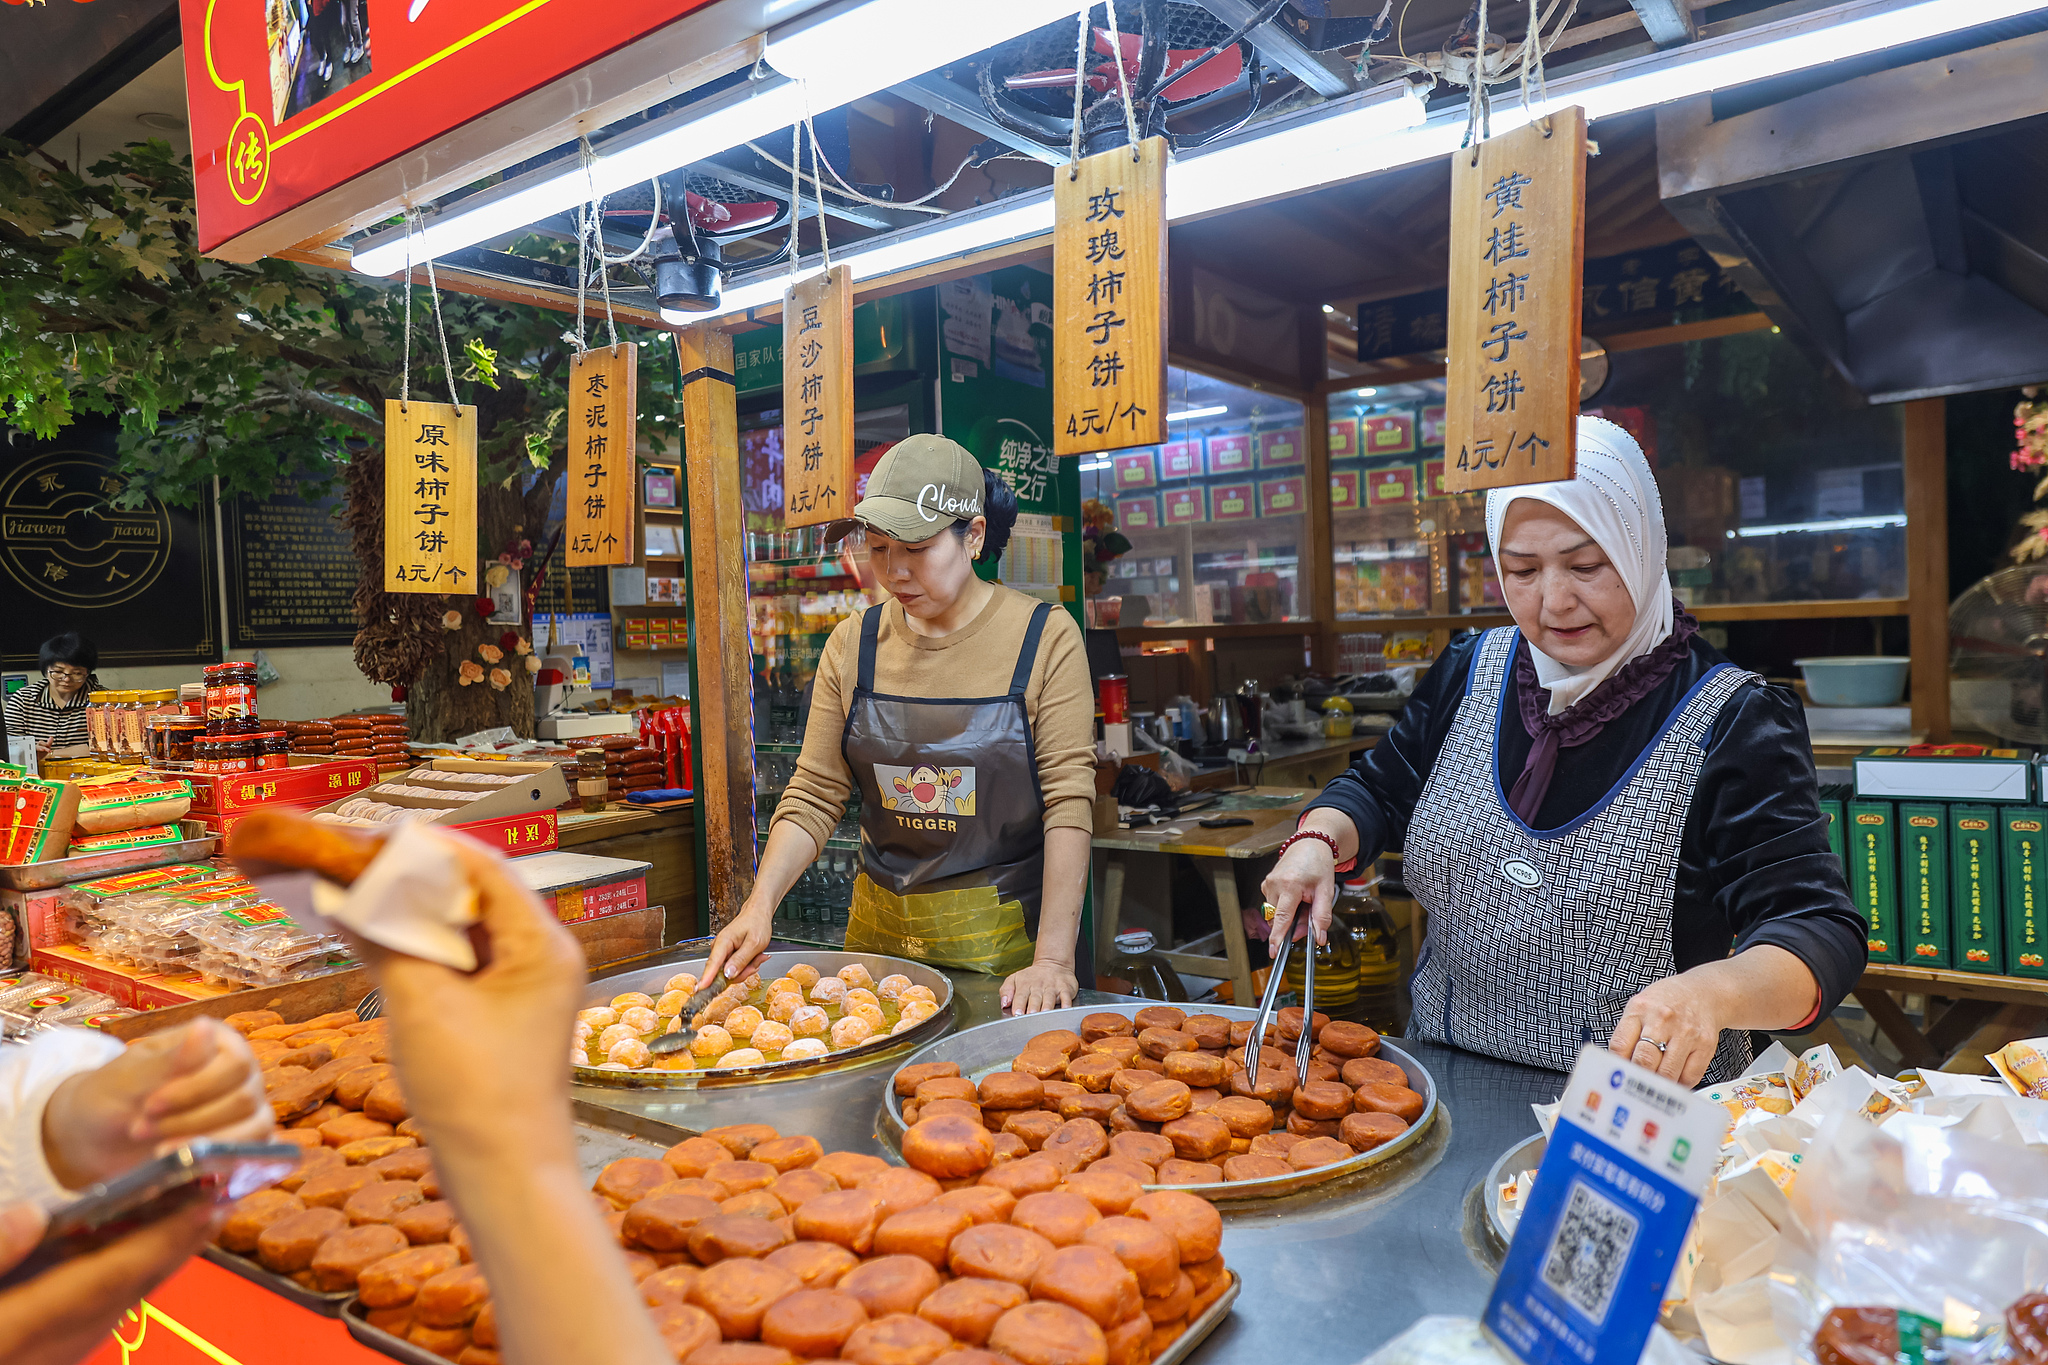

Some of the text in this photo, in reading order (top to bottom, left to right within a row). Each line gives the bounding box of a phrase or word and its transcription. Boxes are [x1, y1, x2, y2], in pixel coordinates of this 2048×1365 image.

[234, 132, 265, 187] 传
[1085, 186, 1126, 388] 玫瑰柿子饼
[1481, 171, 1532, 414] 黄桂柿子饼
[799, 304, 824, 472] 豆沙柿子饼
[1066, 401, 1147, 437] 4元/个
[584, 373, 609, 520] 枣泥柿子饼
[998, 438, 1060, 475] 纯净之道
[1456, 430, 1550, 473] 4元/个
[414, 423, 450, 553] 原味柿子饼
[790, 484, 837, 514] 4元/个
[572, 530, 618, 554] 4元/个
[395, 562, 467, 585] 4元/个
[328, 770, 362, 789] 甜蜜
[504, 823, 540, 845] 送礼
[895, 814, 957, 833] TIGGER
